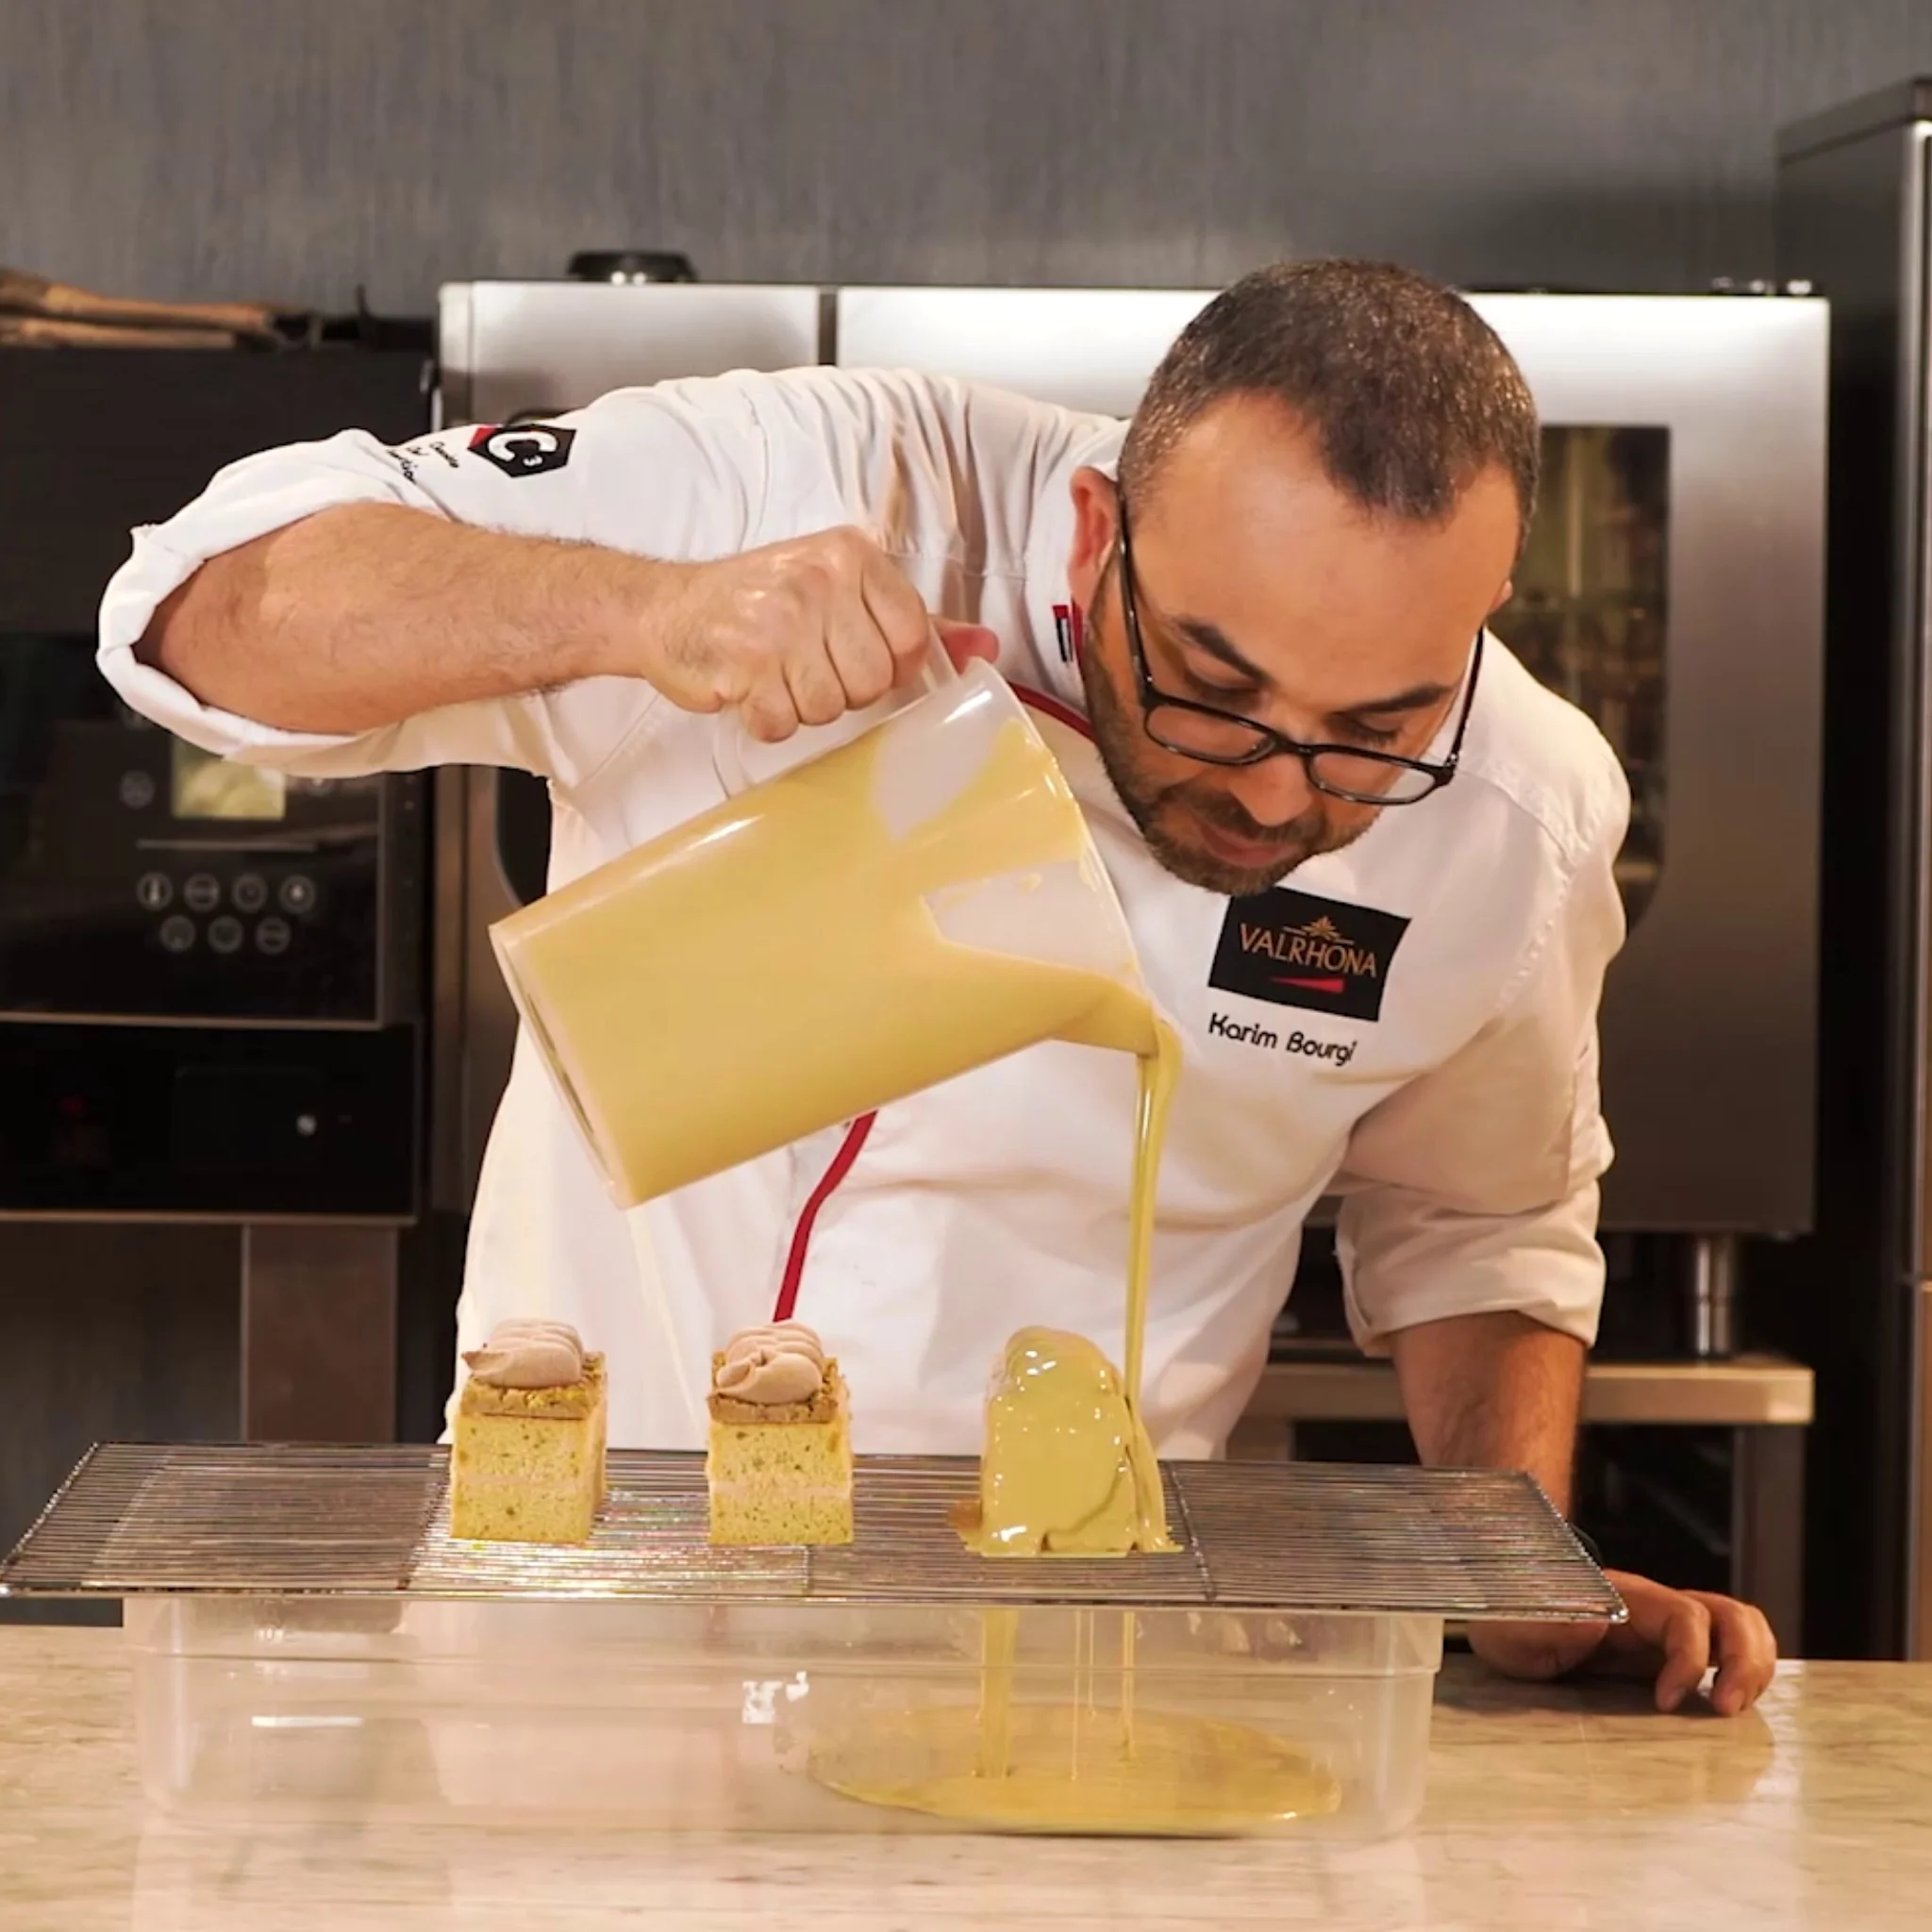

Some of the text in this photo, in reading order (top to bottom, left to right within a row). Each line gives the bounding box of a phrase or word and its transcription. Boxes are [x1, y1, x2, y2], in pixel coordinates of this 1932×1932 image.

[1240, 923, 1377, 978] VALRHONA
[1208, 1012, 1357, 1067] Karim Bourgi
